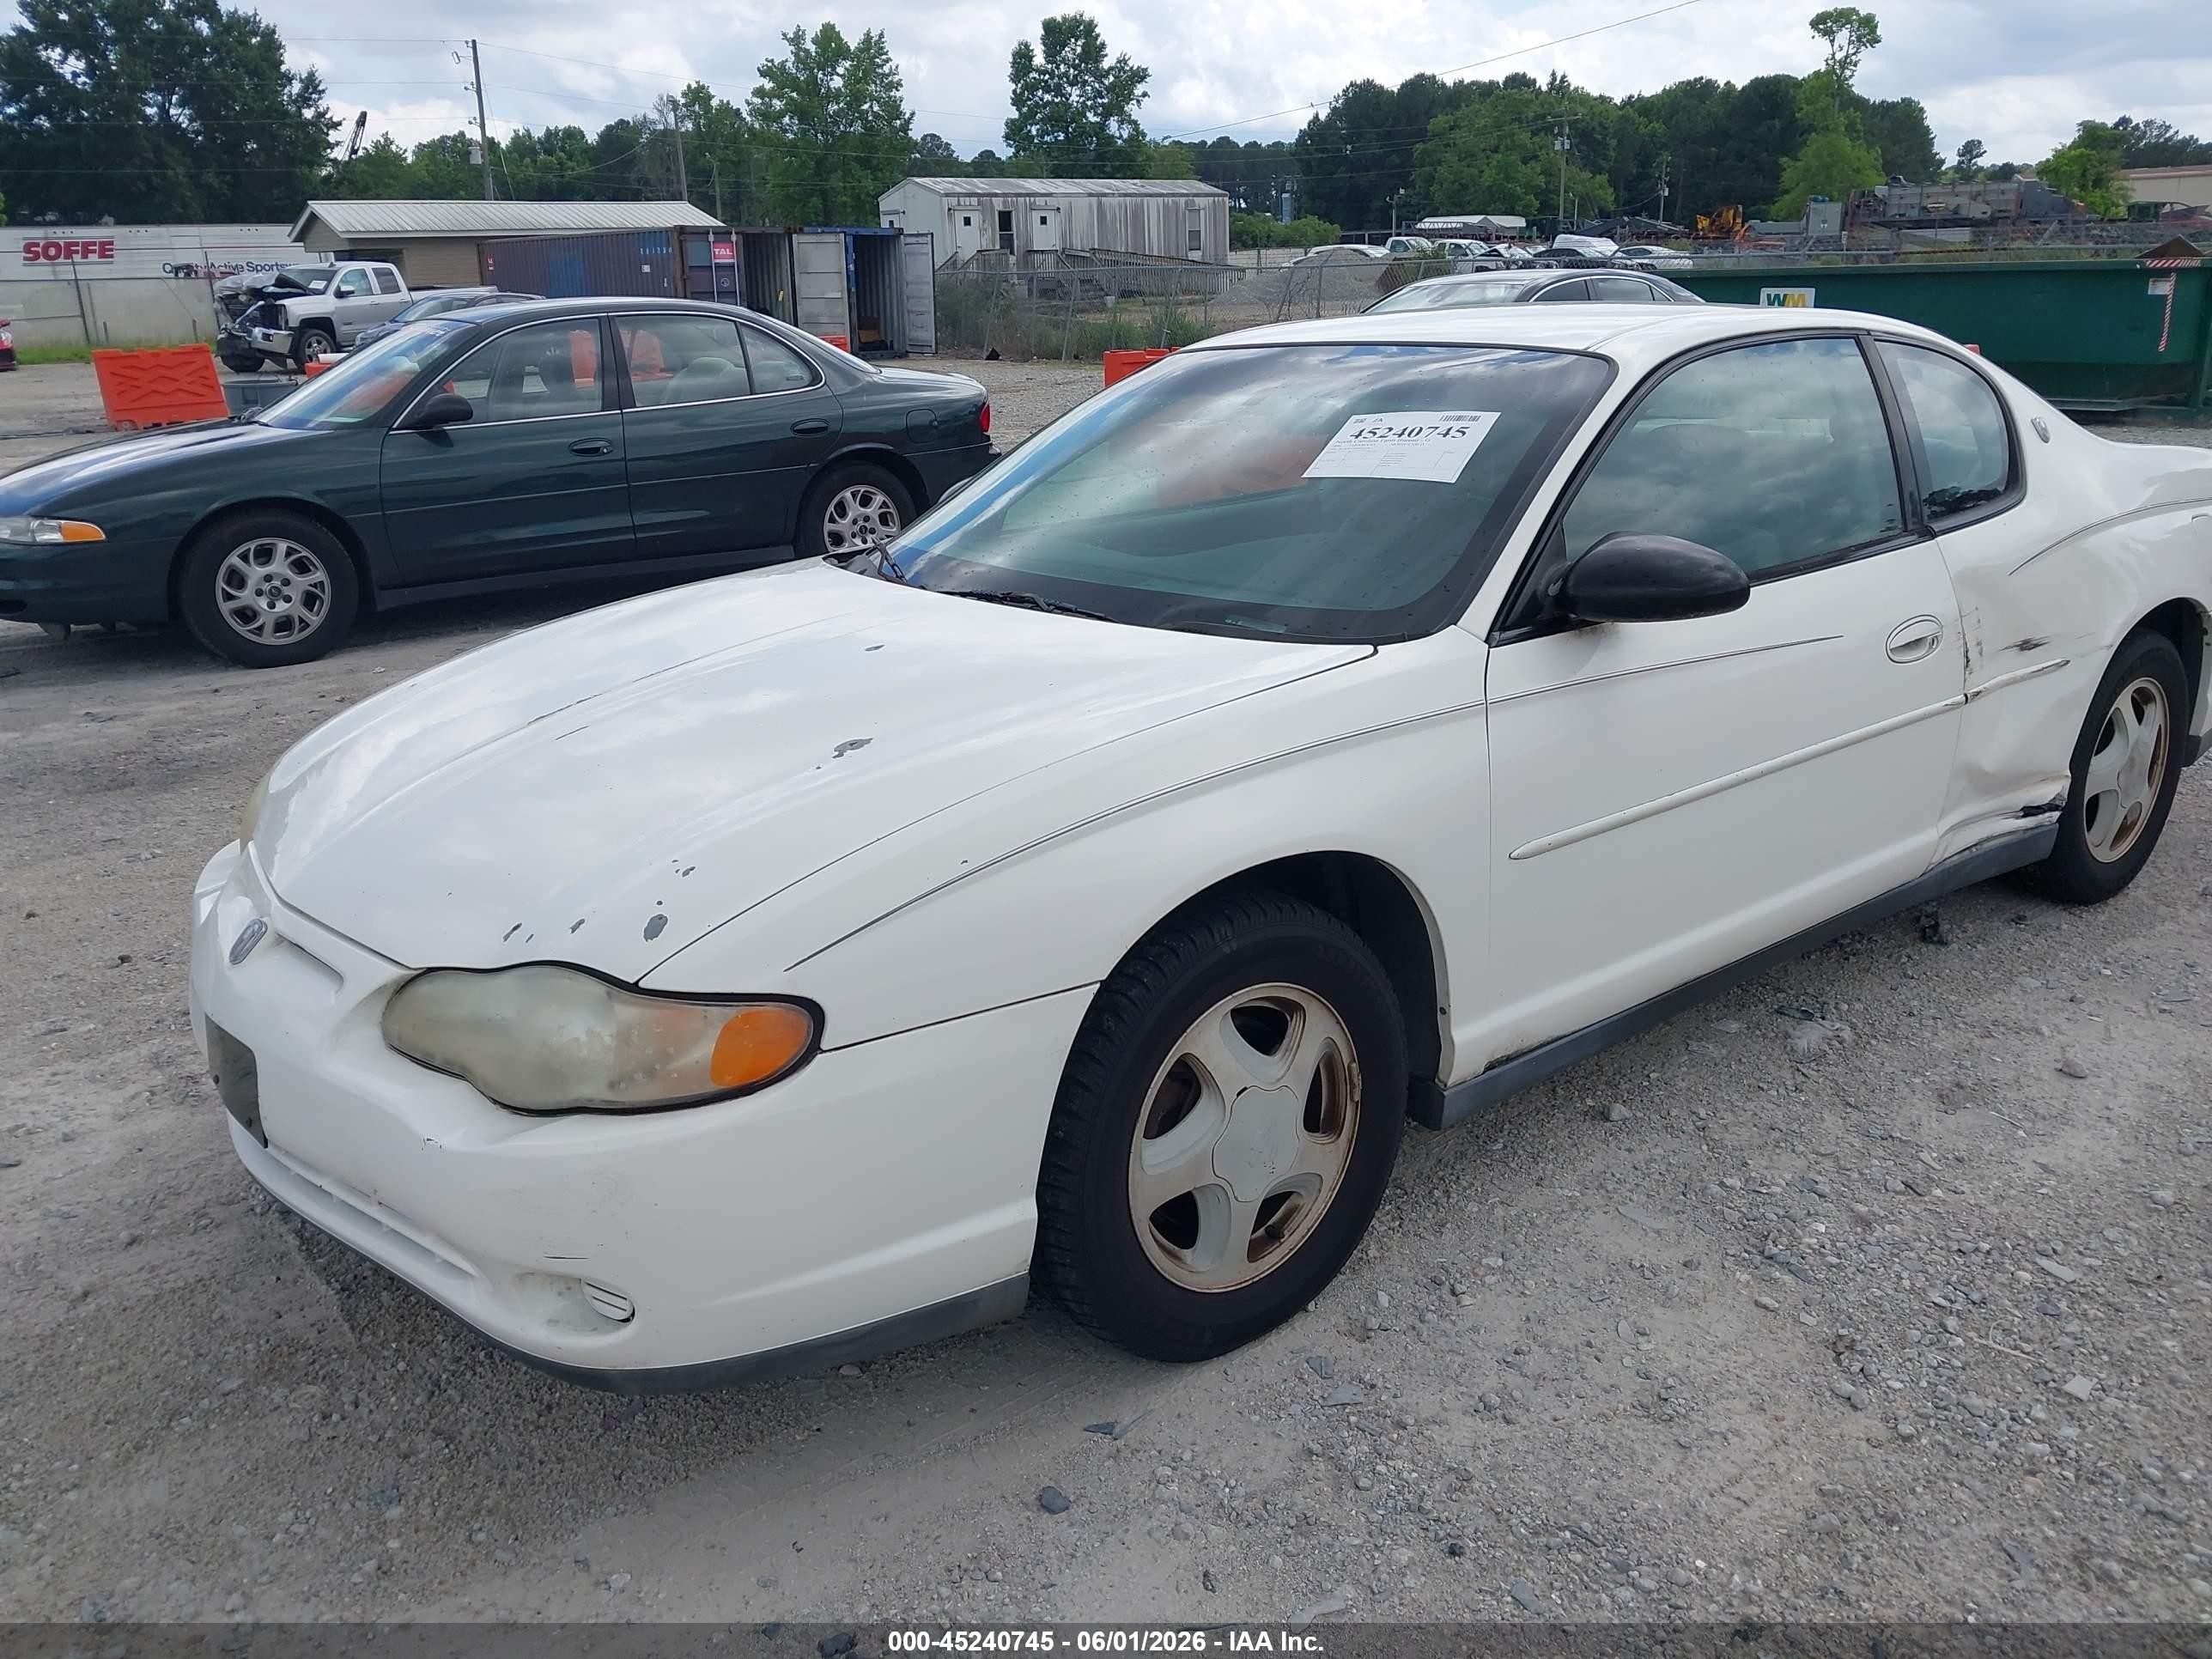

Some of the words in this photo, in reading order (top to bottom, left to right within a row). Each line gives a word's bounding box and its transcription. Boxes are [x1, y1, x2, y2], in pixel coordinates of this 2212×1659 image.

[22, 240, 114, 262] SOFFE
[1766, 293, 1807, 307] WM
[1350, 426, 1471, 440] 45240745
